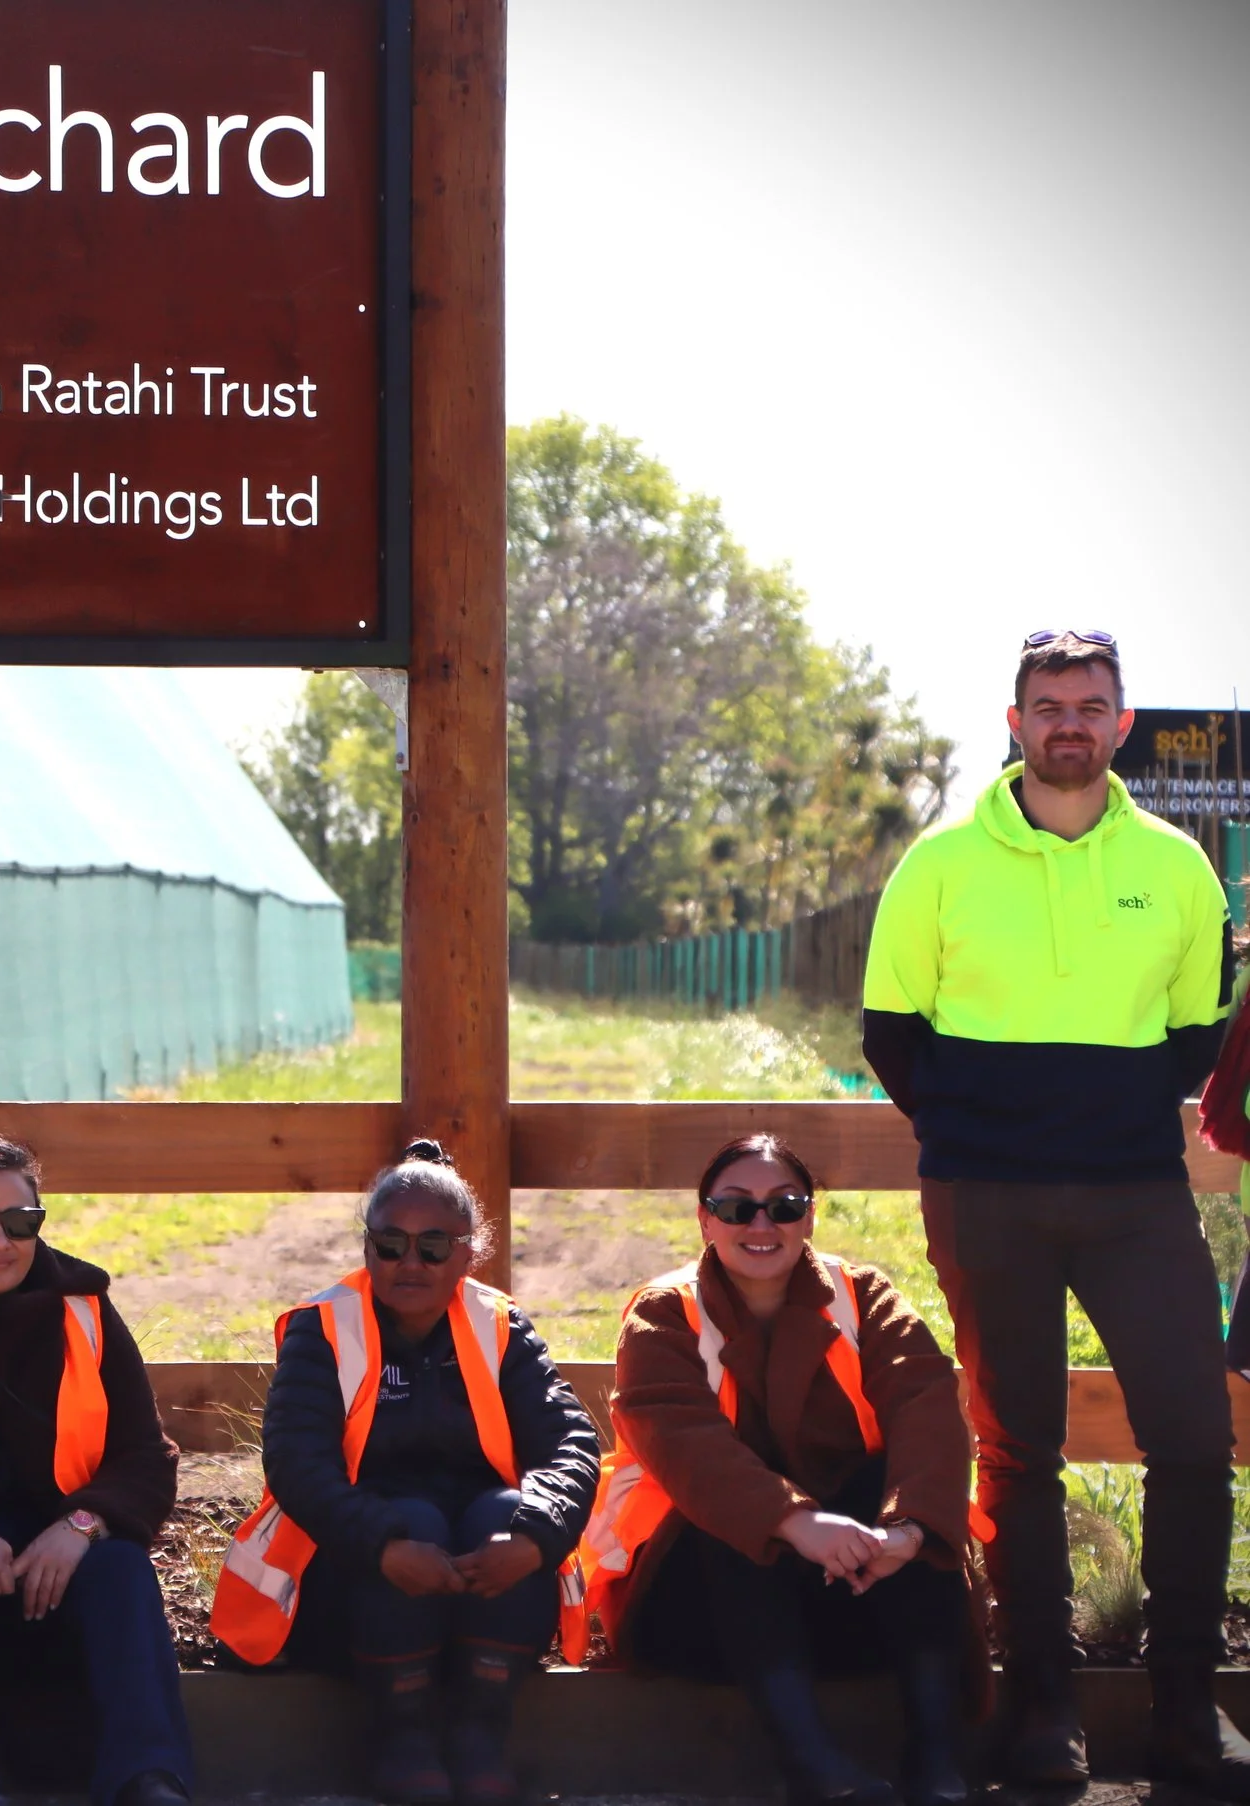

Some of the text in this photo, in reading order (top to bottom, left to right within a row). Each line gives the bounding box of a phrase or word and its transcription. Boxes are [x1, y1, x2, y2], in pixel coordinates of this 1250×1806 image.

[22, 362, 174, 417] Ratahi
[190, 366, 318, 419] Trust
[241, 475, 319, 527] Ltd
[1118, 896, 1145, 909] sch
